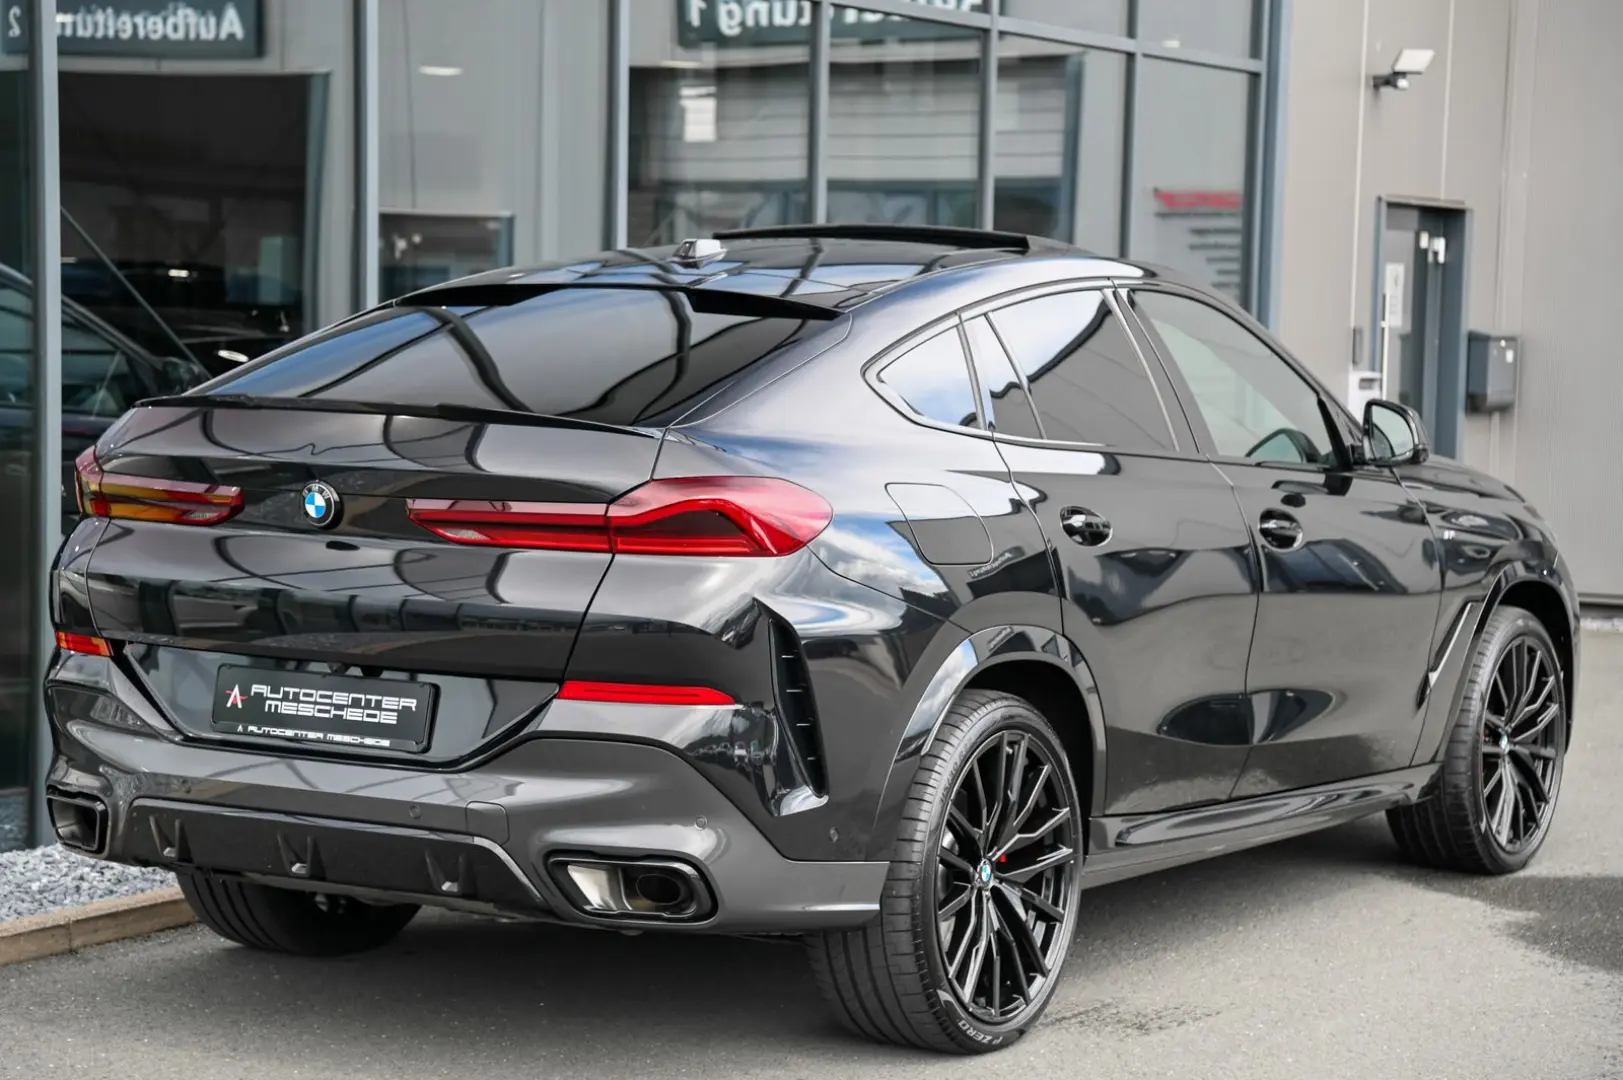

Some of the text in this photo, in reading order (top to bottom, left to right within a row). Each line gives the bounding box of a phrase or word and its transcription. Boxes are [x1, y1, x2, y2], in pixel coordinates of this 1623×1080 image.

[251, 684, 417, 711] AUTOCENTER
[265, 700, 398, 724] MESCHEDE
[248, 726, 324, 740] AUTOCENTER
[327, 733, 390, 747] MESCHEDE
[958, 1020, 993, 1044] ZERO
